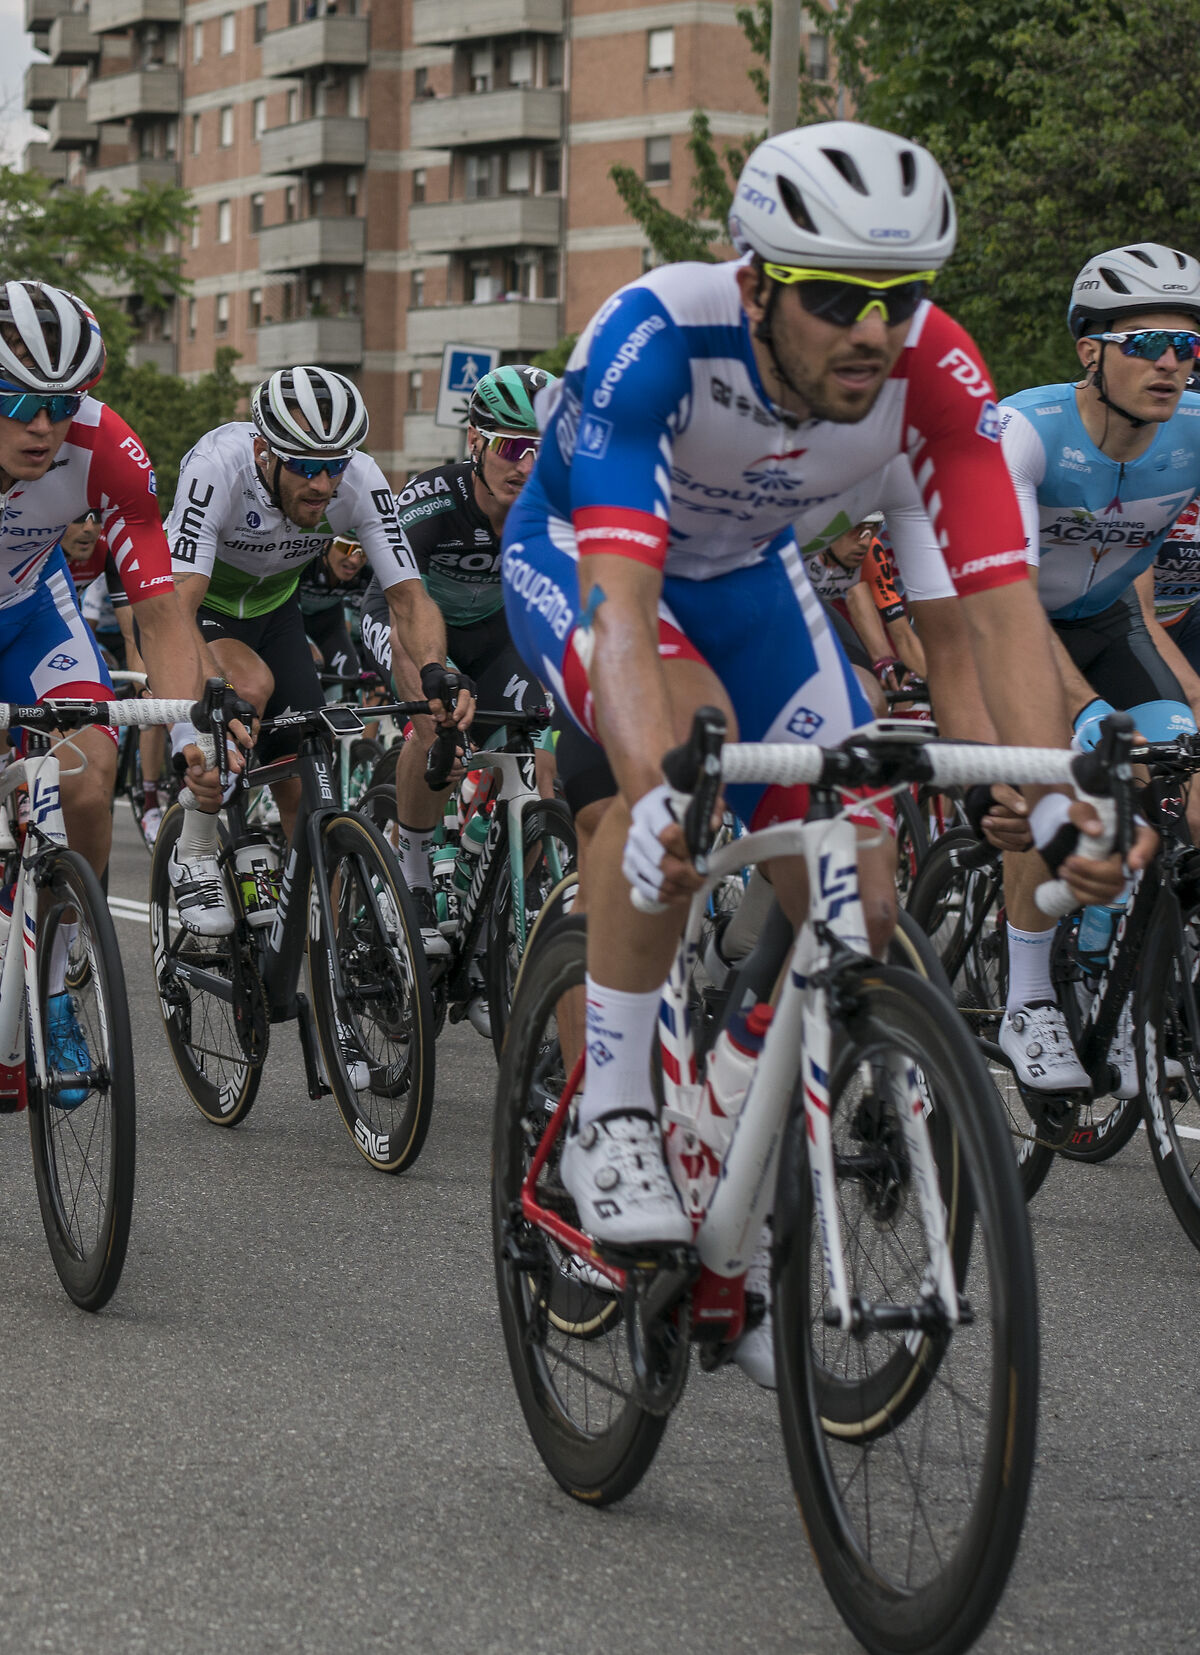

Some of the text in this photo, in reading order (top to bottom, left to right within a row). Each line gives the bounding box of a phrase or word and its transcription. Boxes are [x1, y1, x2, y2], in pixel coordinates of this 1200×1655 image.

[869, 228, 910, 239] GIRO
[593, 314, 668, 408] Groupama
[936, 347, 992, 398] FDJ
[119, 436, 151, 469] FDJ
[456, 476, 470, 501] BORA
[671, 464, 841, 509] Groupam
[171, 478, 215, 565] BMC
[371, 488, 416, 570] BMC
[1040, 523, 1164, 546] ACADEM
[139, 574, 174, 588] LAPIE
[429, 553, 503, 573] BO
[951, 549, 1024, 579] LAPIER
[502, 542, 575, 642] Groupama
[361, 613, 393, 671] BORA
[18, 707, 46, 718] PRO
[314, 761, 332, 800] BMC
